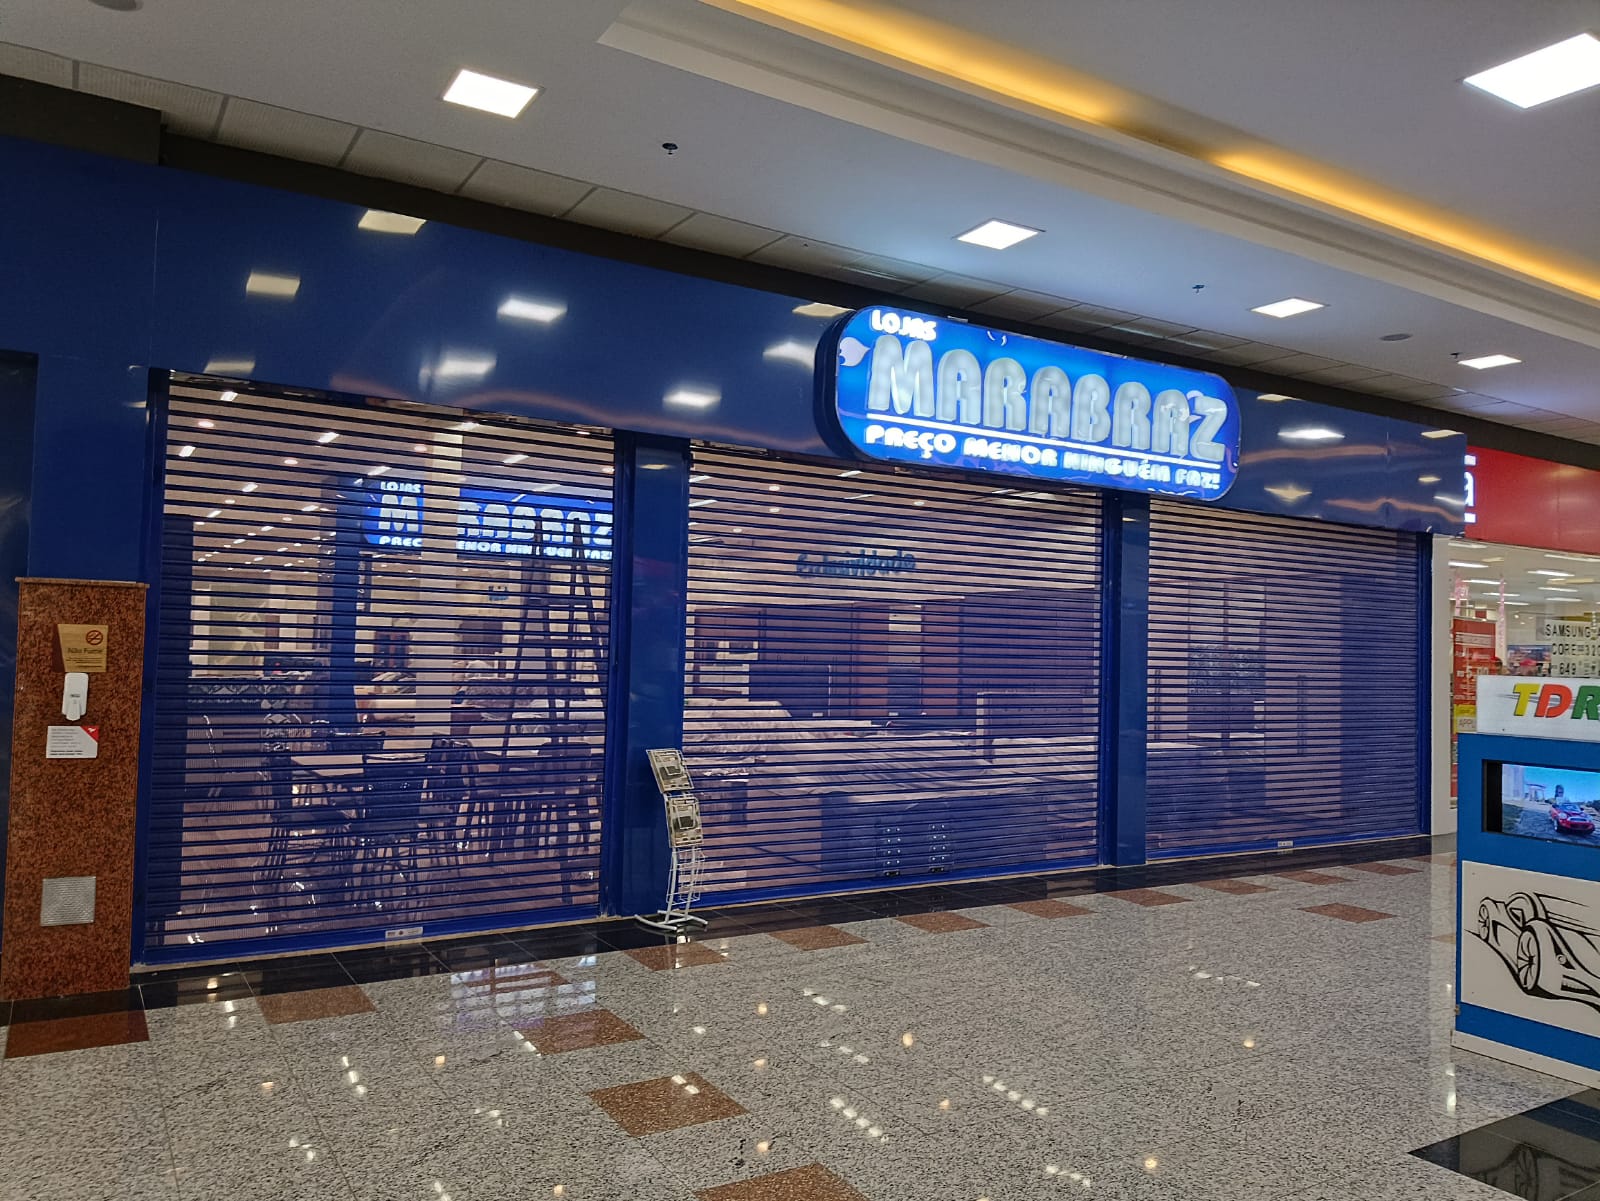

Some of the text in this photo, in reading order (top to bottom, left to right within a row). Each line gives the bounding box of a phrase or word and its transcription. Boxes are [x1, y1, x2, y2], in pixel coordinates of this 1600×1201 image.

[871, 309, 938, 341] LOJAS
[866, 333, 1228, 462] MARABRAZ
[865, 424, 1222, 490] PREÇO MENOR NINGUÉM FAZ!
[380, 481, 422, 494] LOJAS
[1545, 623, 1590, 638] SAMSUNG
[1552, 643, 1576, 656] CORE
